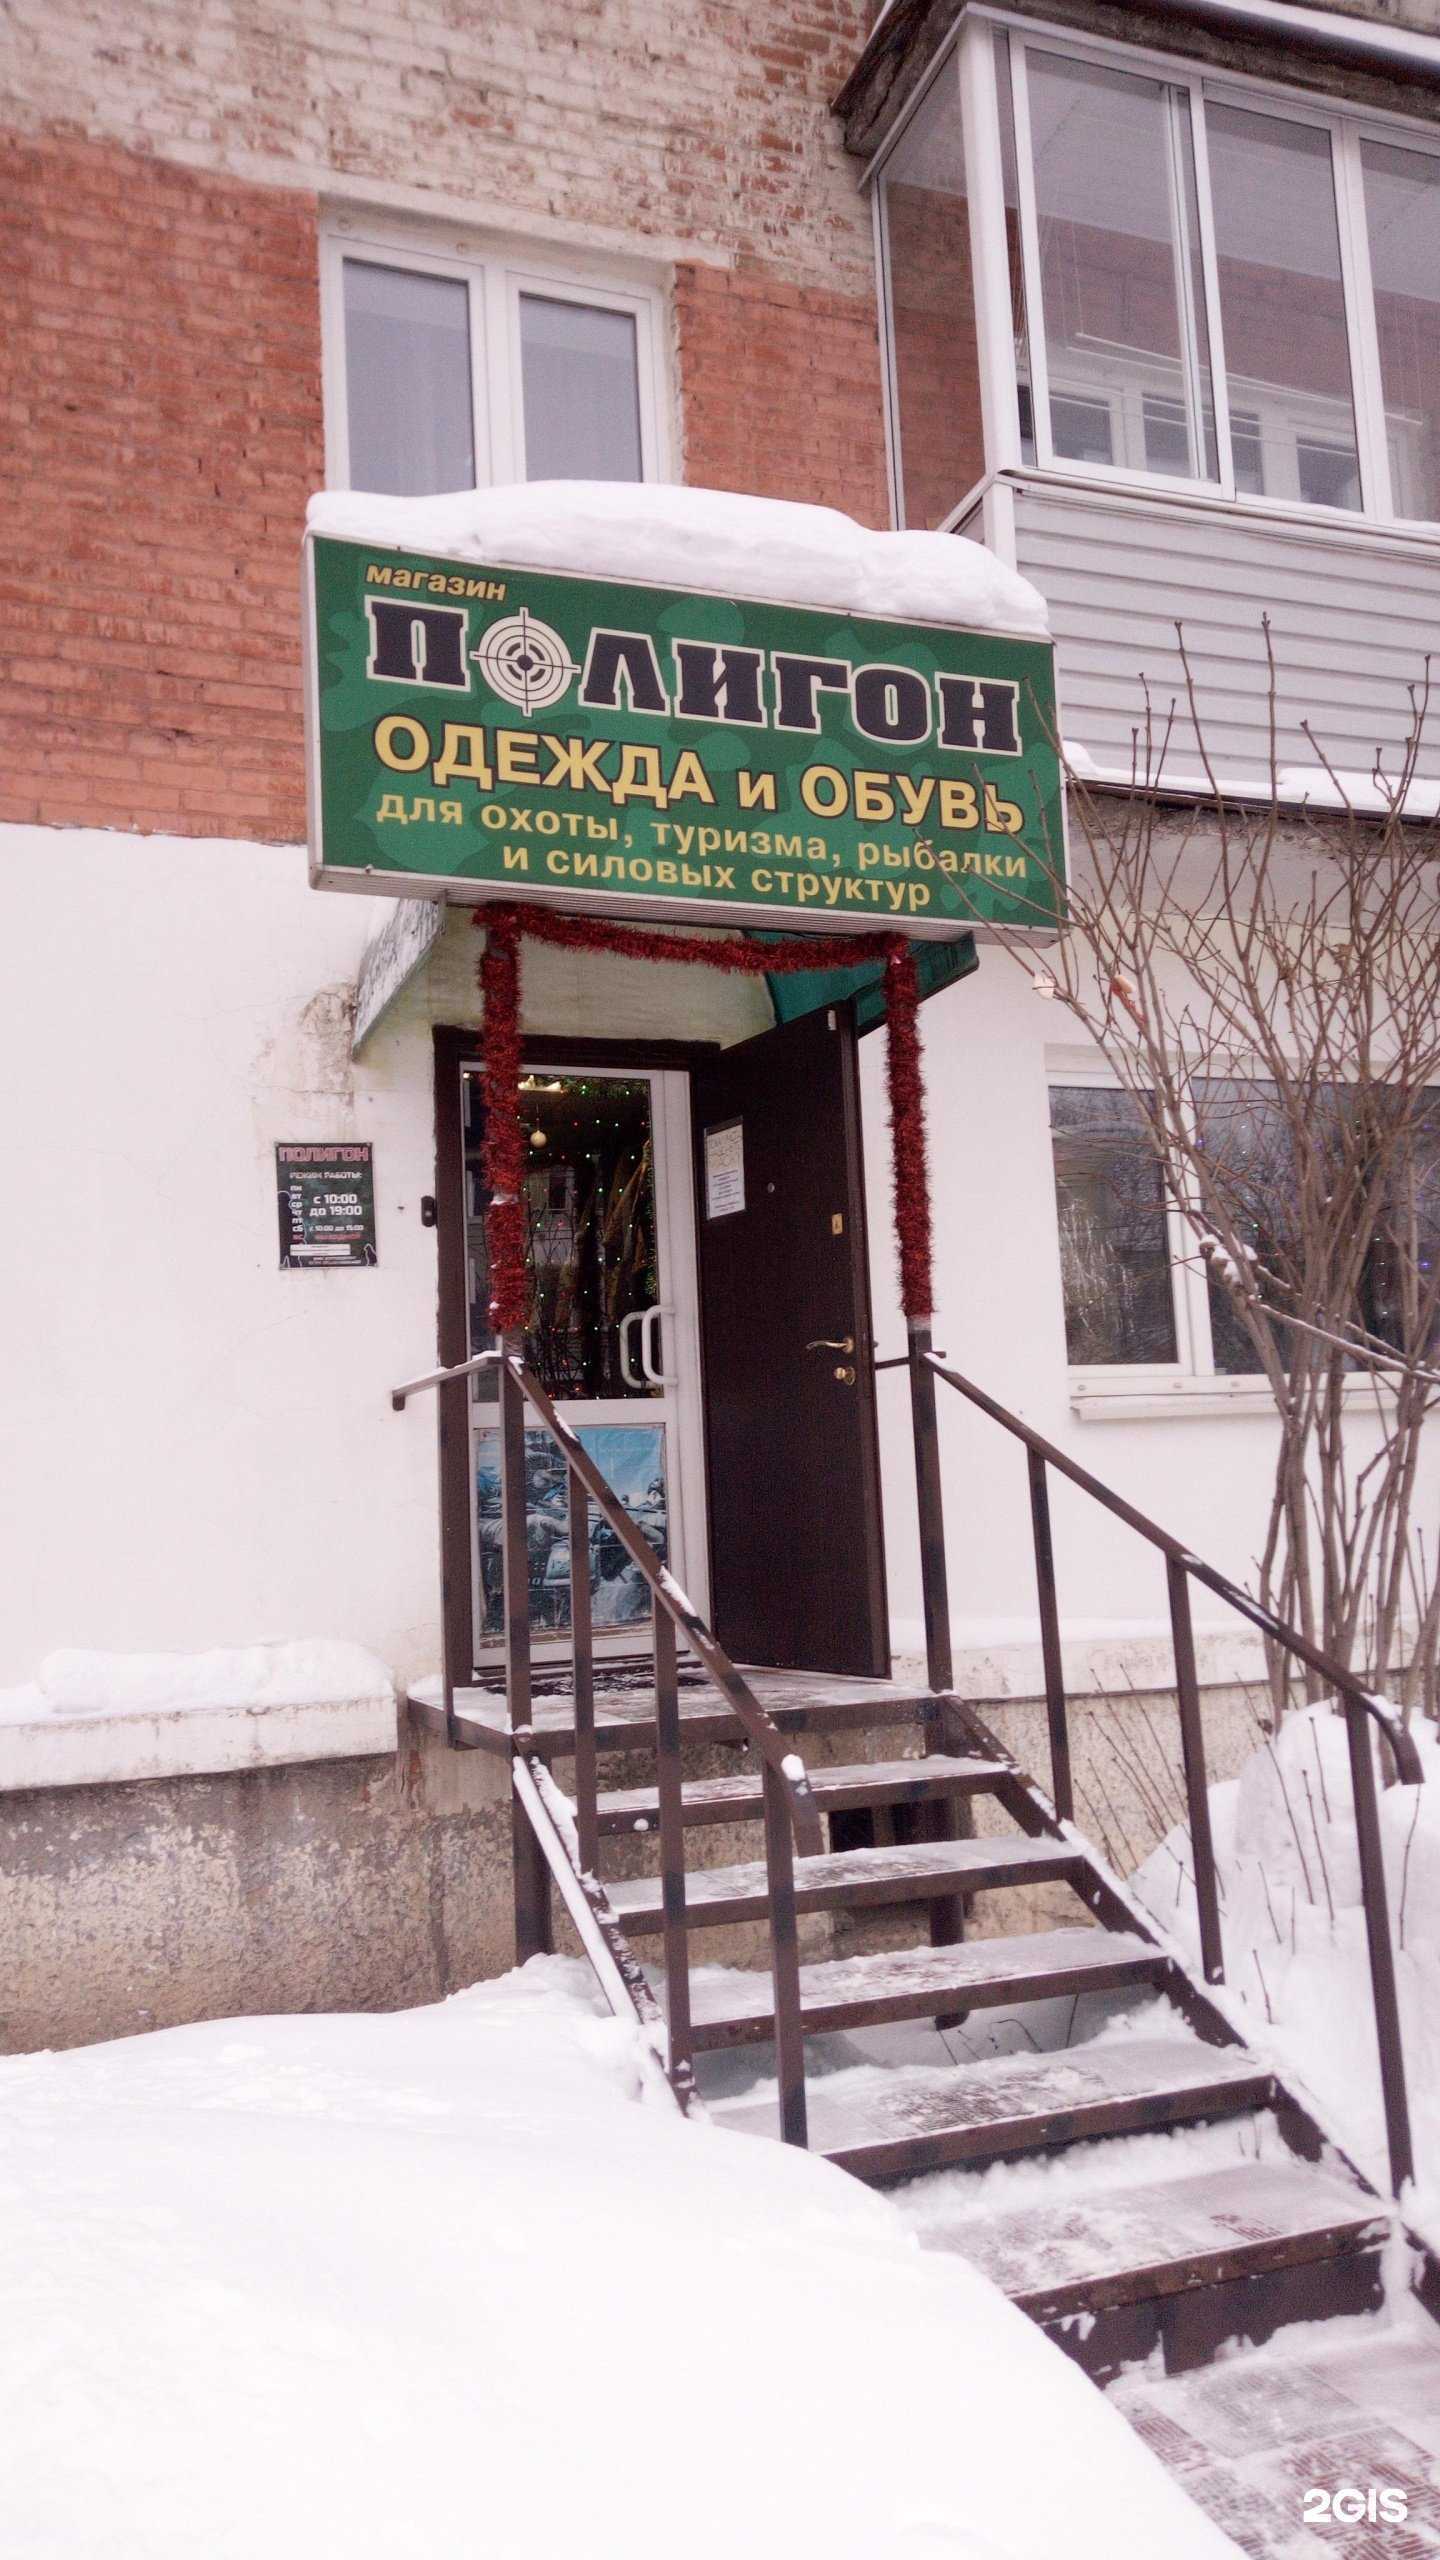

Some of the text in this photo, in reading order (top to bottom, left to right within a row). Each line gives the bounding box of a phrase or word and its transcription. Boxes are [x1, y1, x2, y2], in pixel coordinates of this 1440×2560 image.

[366, 565, 506, 601] магазин
[373, 714, 1025, 835] ОДЕЖДА и ОБУВЬ
[376, 794, 1027, 878] для охоты, туризма, рыбалки
[503, 845, 931, 911] и силовых структур
[279, 1147, 369, 1161] ПОЛИГОН
[324, 1193, 358, 1204] 10:00
[329, 1205, 363, 1216] 19:00
